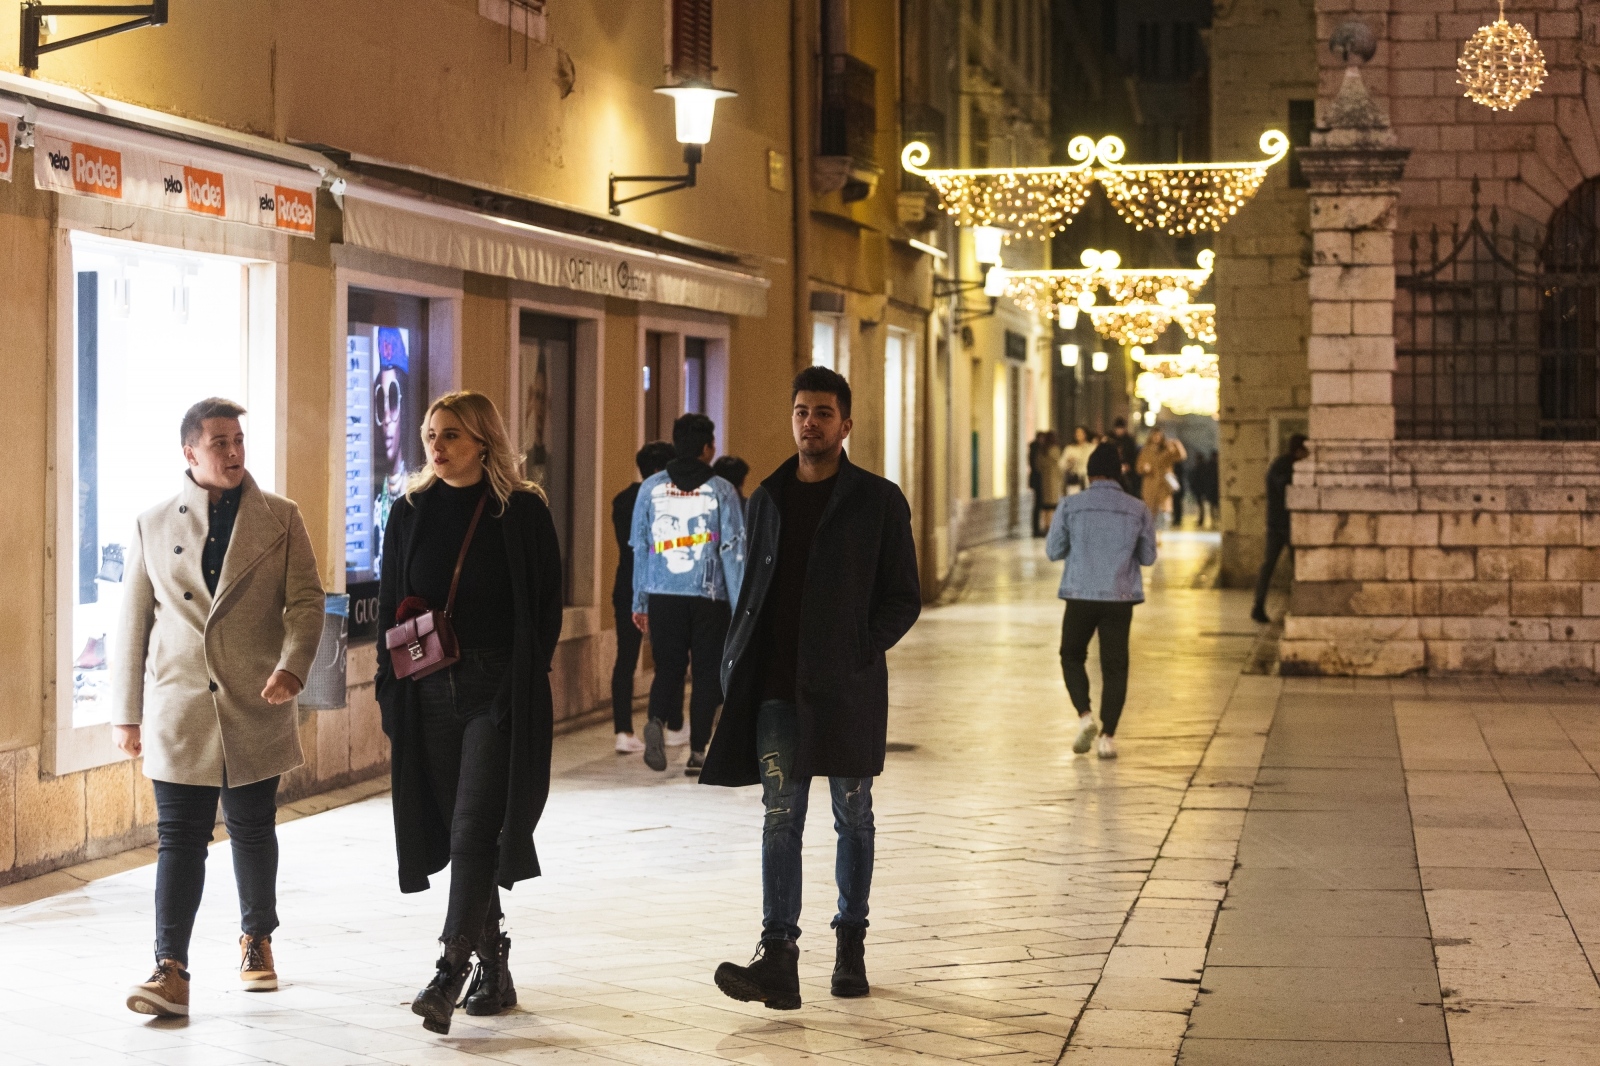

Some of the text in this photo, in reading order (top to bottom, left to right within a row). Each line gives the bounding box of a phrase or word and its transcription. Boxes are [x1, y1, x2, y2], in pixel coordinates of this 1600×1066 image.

[75, 152, 118, 190] Rodea
[187, 175, 222, 209] Rodea
[277, 194, 313, 225] Rodea
[355, 597, 379, 624] GUC
